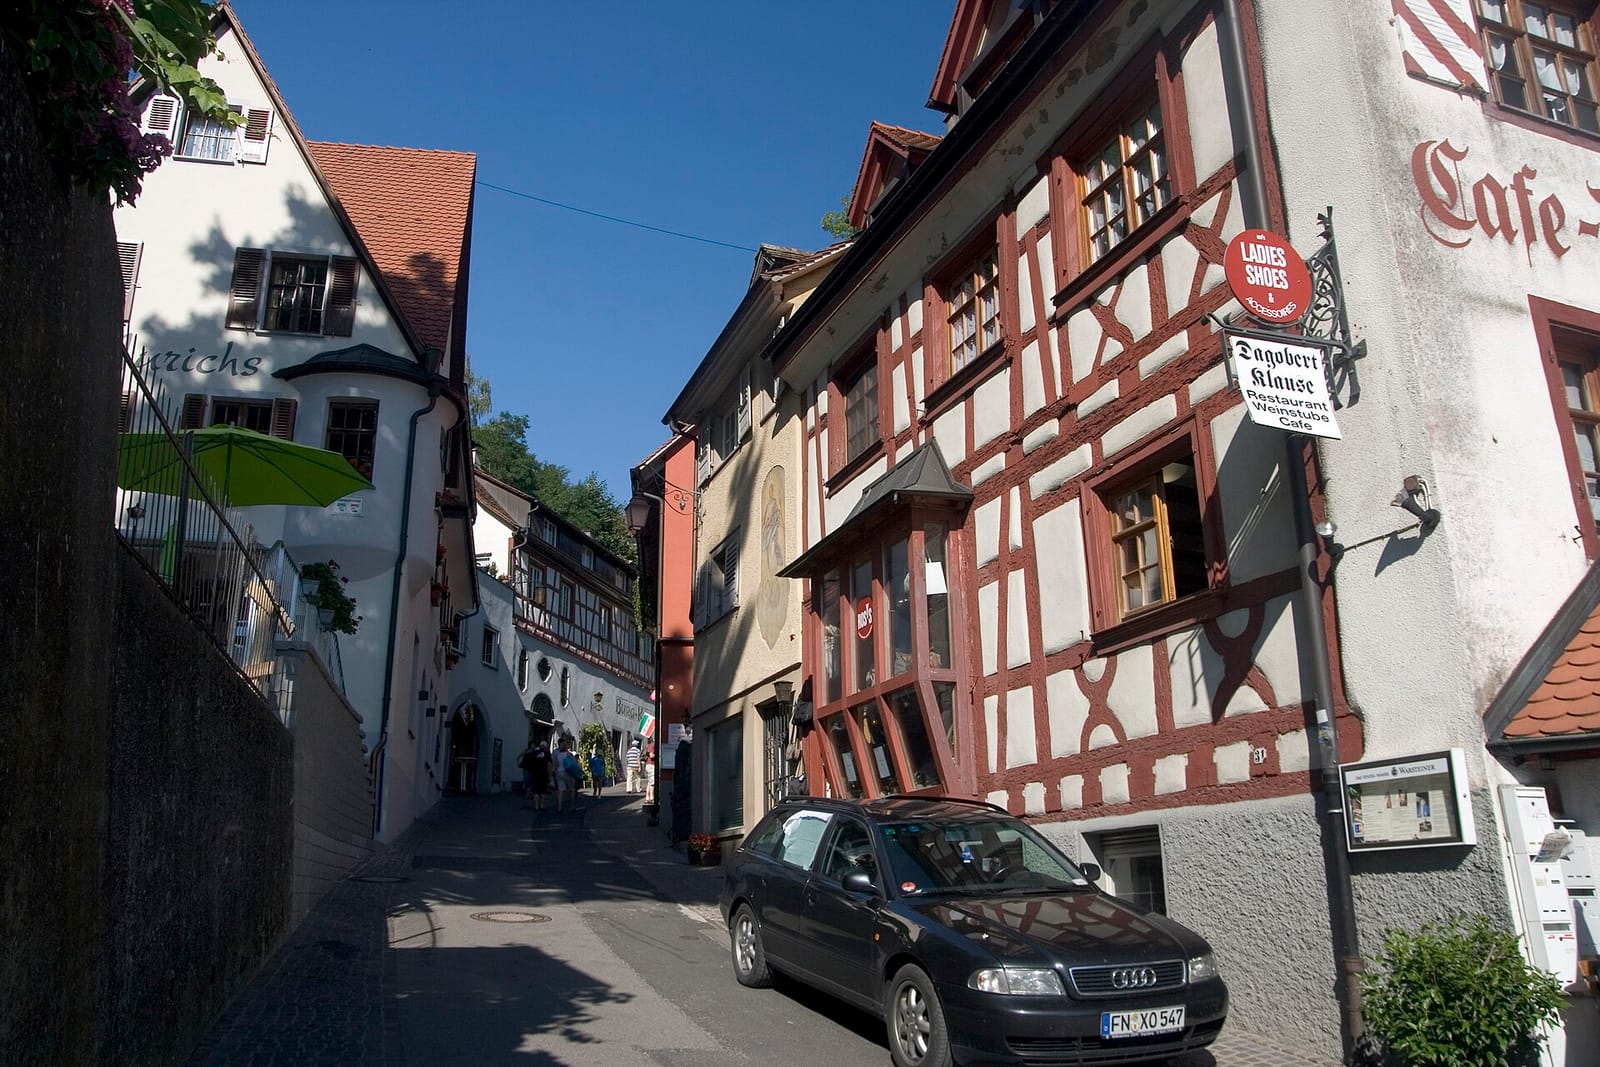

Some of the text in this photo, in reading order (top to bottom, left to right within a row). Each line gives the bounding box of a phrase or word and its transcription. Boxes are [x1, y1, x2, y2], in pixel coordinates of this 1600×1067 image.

[1411, 138, 1600, 268] Cafe-
[1240, 241, 1287, 268] LADIES
[1245, 266, 1289, 290] SHOES
[1268, 292, 1275, 304] &
[1235, 340, 1320, 371] Dagobert
[1251, 366, 1315, 395] Klause
[1246, 390, 1329, 412] Restaurant
[1252, 401, 1330, 424] Weinstube
[1279, 416, 1313, 432] Cafe
[1111, 1014, 1131, 1032] FN
[1140, 1011, 1158, 1030] XO
[1160, 1008, 1184, 1027] 547
